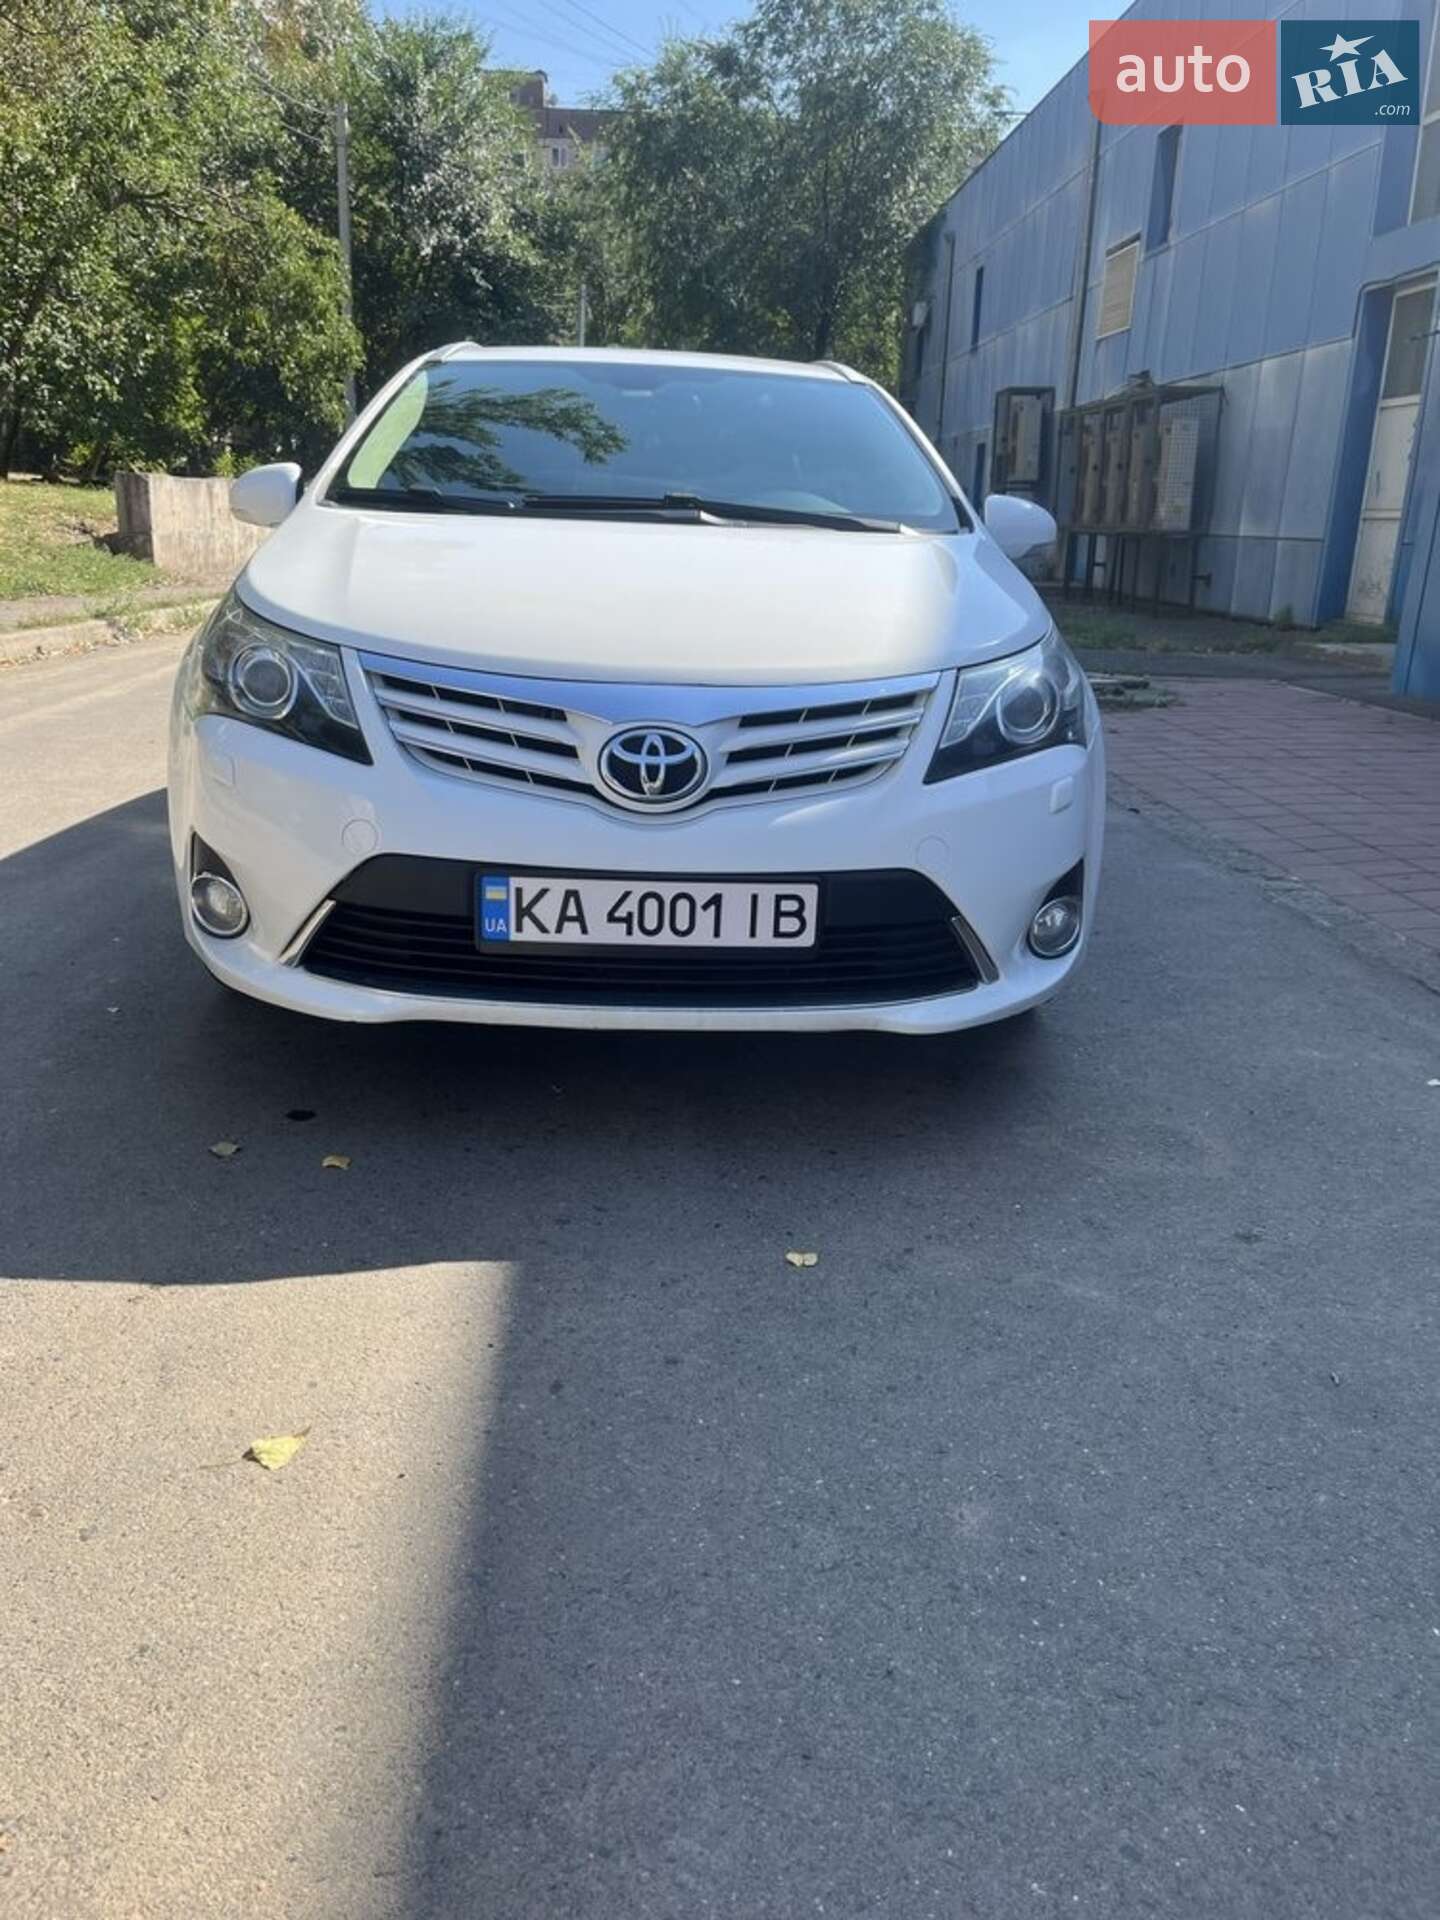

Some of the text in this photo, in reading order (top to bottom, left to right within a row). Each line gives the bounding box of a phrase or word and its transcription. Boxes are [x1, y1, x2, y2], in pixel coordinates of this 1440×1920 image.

[484, 917, 508, 934] UA
[514, 886, 808, 939] KA 4001 IB
